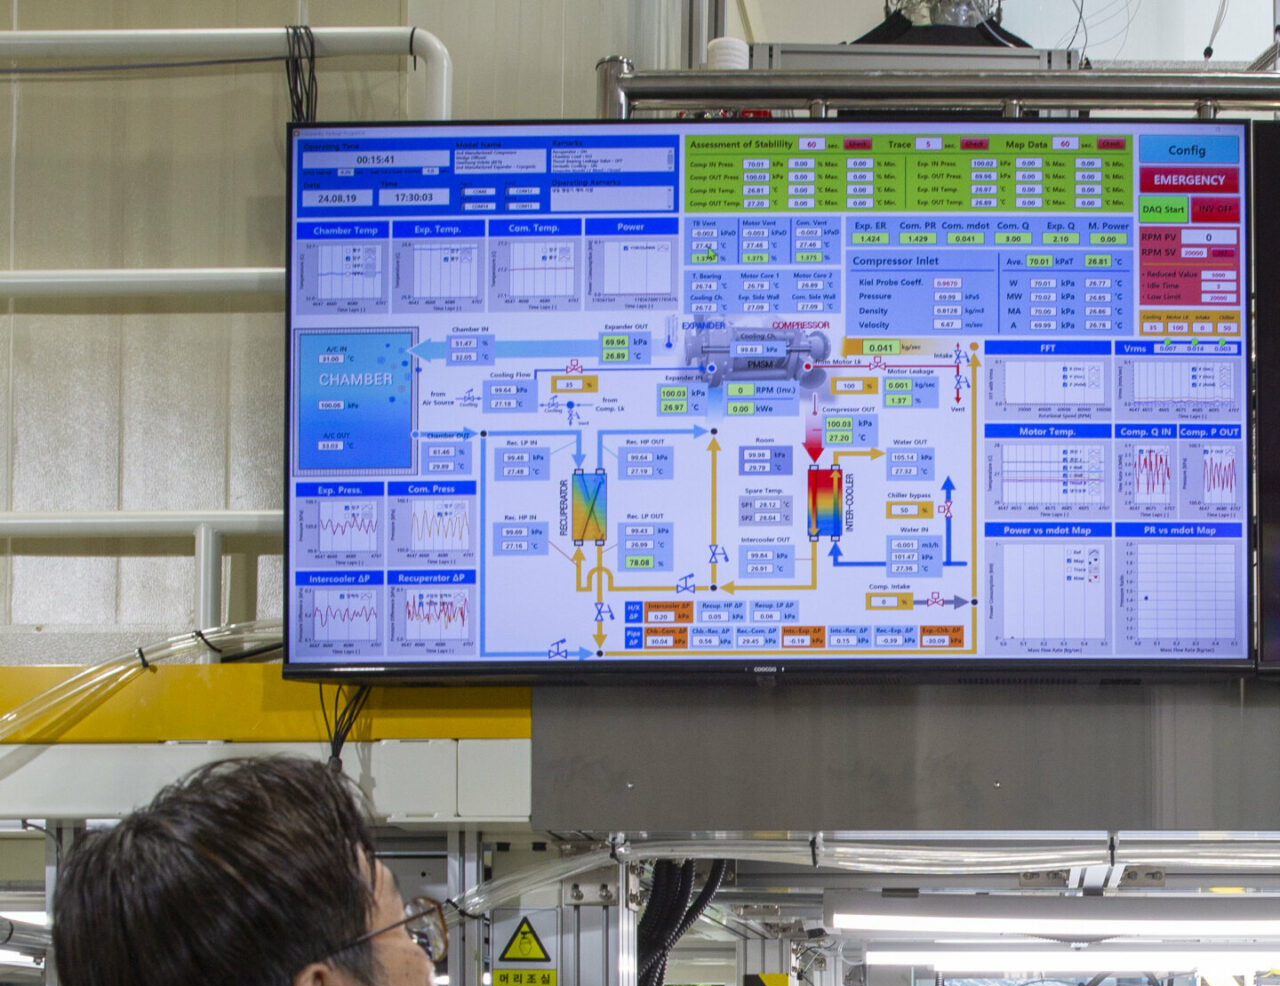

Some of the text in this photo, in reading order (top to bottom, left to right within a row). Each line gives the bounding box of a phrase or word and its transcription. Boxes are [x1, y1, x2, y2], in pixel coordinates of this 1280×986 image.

[690, 141, 741, 149] Assessment
[743, 140, 752, 149] of
[888, 141, 912, 149] Trace
[1006, 141, 1025, 150] Map
[1028, 141, 1048, 149] Data
[1168, 145, 1206, 159] Config
[356, 155, 395, 165] 00:15:41
[1153, 175, 1226, 186] EMERGENCY
[318, 194, 357, 203] 24.08.19
[395, 193, 434, 202] 17:30:03
[1142, 205, 1185, 215] DAQ Start
[414, 225, 462, 234] Exp. Temp.
[508, 224, 560, 233] Com. Temp.
[617, 222, 645, 231] Power
[855, 222, 887, 231] Exp. ER
[900, 222, 937, 230] Com. PR
[941, 222, 990, 230] Com. mdot
[997, 222, 1030, 231] Com. Q
[1047, 222, 1075, 231] Exp. Q
[1088, 222, 1129, 230] M. Power
[313, 226, 378, 236] Chamber Temp
[1141, 233, 1212, 242] RPM PV 0
[852, 257, 939, 267] Compressor Inlet
[859, 292, 892, 300] Pressure
[1061, 293, 1075, 301] kPa
[859, 307, 888, 316] Density
[1008, 307, 1021, 315] MA
[682, 322, 726, 330] EXPANDER
[859, 321, 890, 330] Velocity
[633, 338, 648, 346] kPa
[869, 344, 893, 352] 0.041
[1040, 344, 1056, 352] FFT
[1124, 345, 1147, 353] Vrms
[747, 361, 774, 369] PMSM
[909, 368, 934, 376] Leakage
[319, 373, 393, 386] CHAMBER
[756, 386, 774, 394] RPM
[776, 386, 796, 395] (Inv.)
[891, 397, 907, 405] 1.37
[755, 405, 773, 413] kWe
[827, 420, 873, 428] 100.03 kPa
[1019, 427, 1076, 436] Motor Temp.
[1120, 427, 1172, 437] Comp. Q IN
[1180, 427, 1240, 437] Comp. P OUT
[829, 434, 850, 442] 27.20
[318, 486, 363, 495] Exp. Press.
[408, 485, 455, 493] Com. Press
[1003, 527, 1031, 535] Power
[1046, 526, 1069, 535] mdot
[1071, 526, 1092, 536] Map
[1144, 527, 1156, 535] PR
[1170, 526, 1194, 535] mdot
[1196, 526, 1216, 536] Map
[629, 559, 650, 567] 78.08
[309, 575, 355, 583] Intercooler
[398, 574, 450, 584] Recuperator
